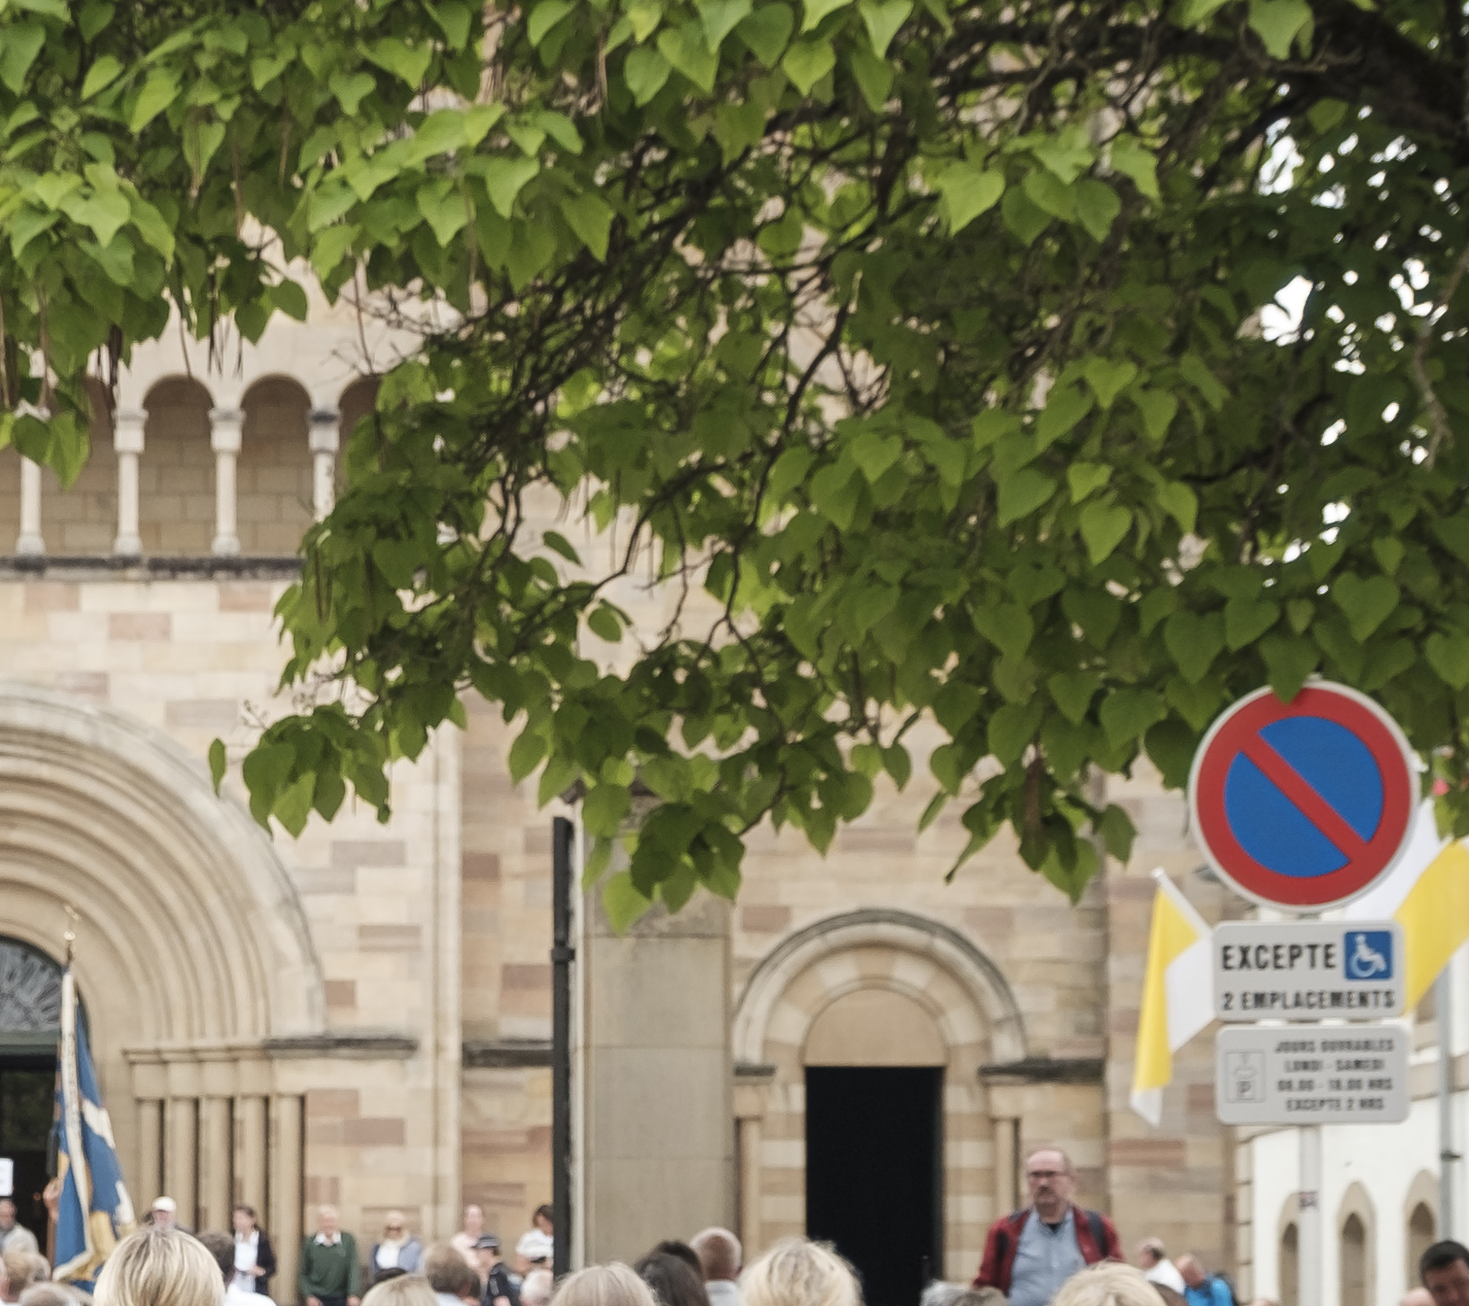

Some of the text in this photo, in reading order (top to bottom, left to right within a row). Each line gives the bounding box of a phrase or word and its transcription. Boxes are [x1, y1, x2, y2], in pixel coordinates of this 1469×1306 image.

[1222, 943, 1337, 970] EXCEPTE
[1223, 990, 1395, 1010] 2 EMPLACEMENTS
